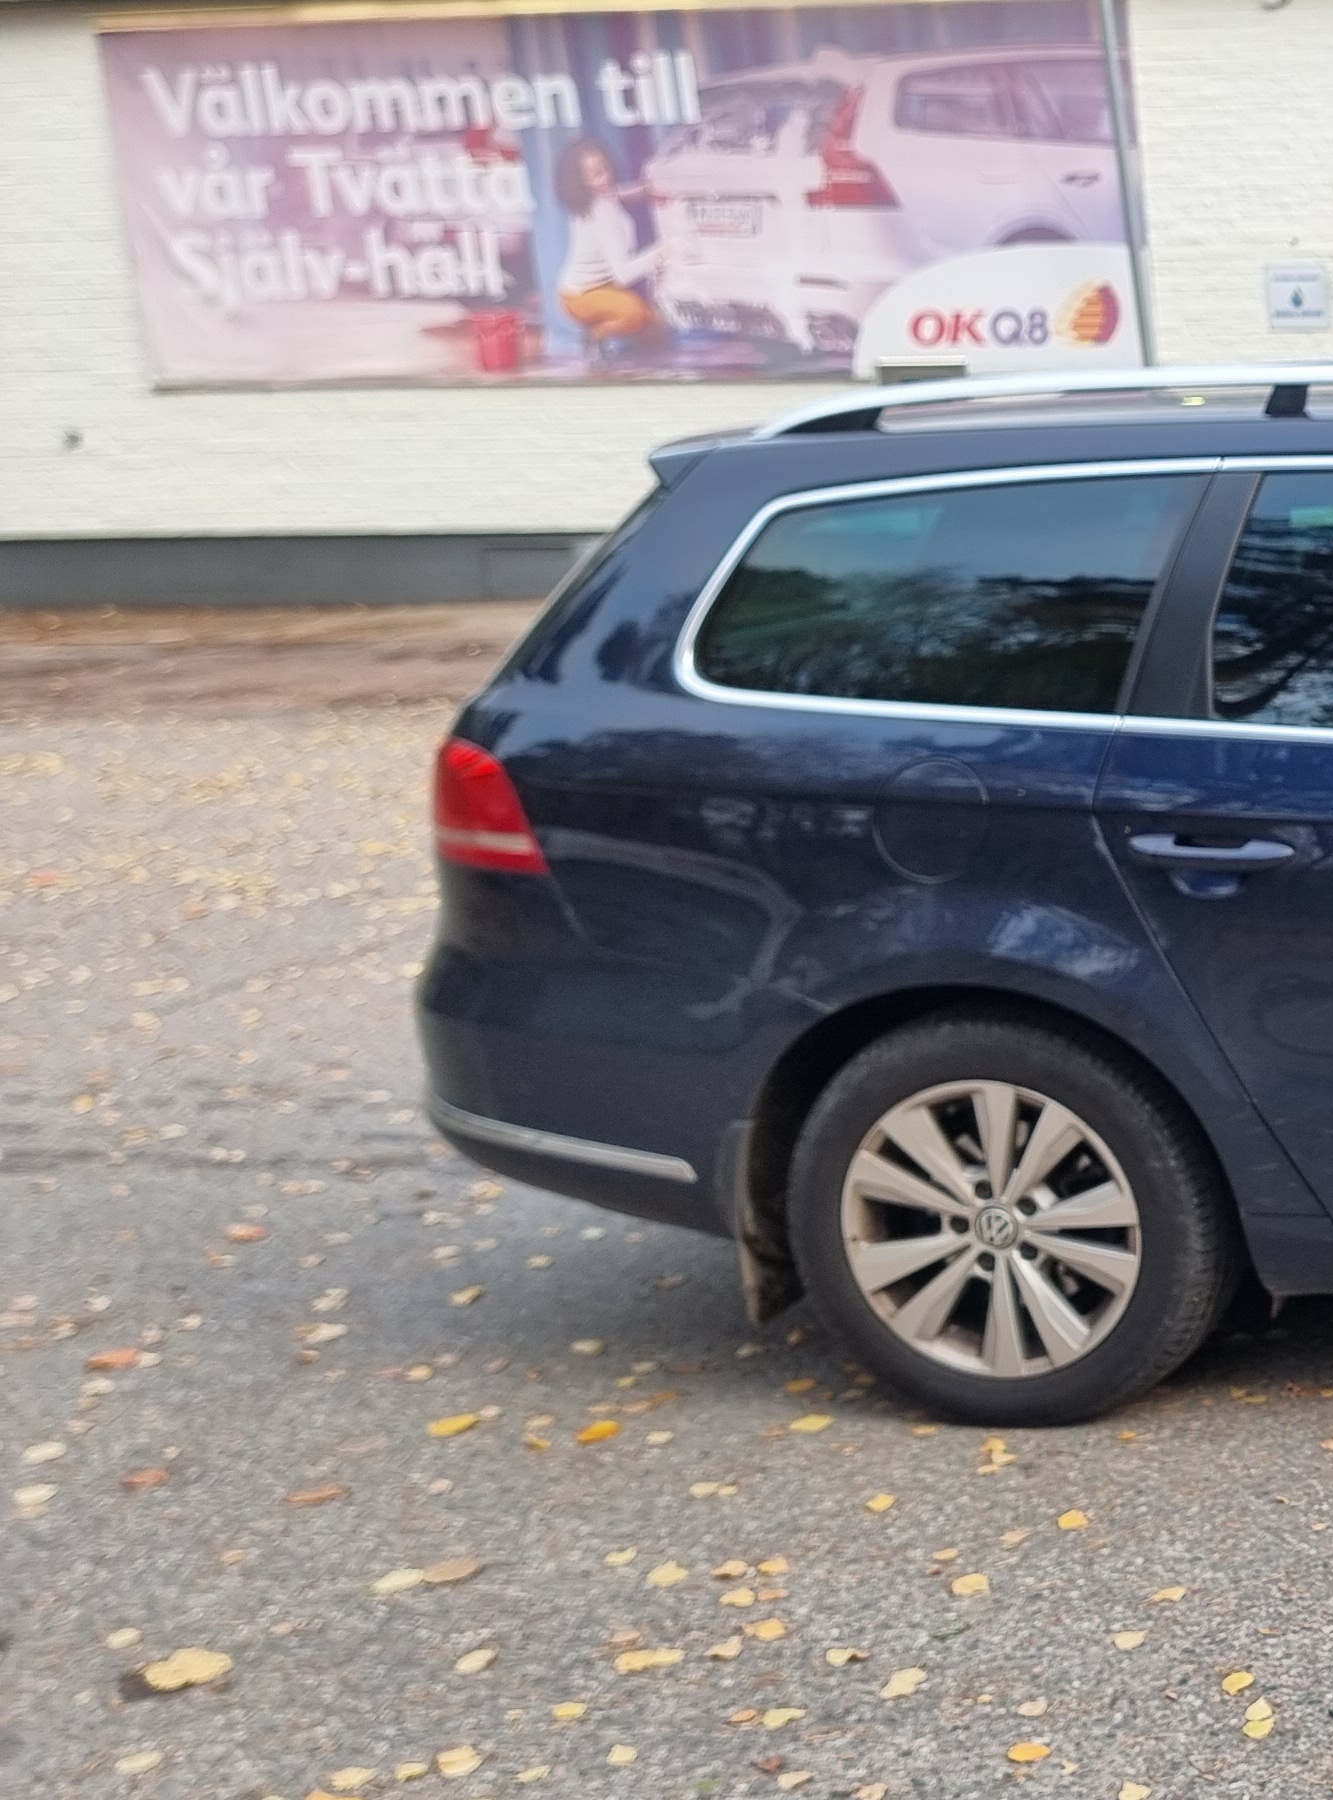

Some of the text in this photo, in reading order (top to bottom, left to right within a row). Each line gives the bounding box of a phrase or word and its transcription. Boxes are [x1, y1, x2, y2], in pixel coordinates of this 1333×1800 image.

[141, 49, 702, 139] Välkommen till
[158, 141, 537, 221] vår Tvätta
[170, 222, 507, 311] Själv-hall
